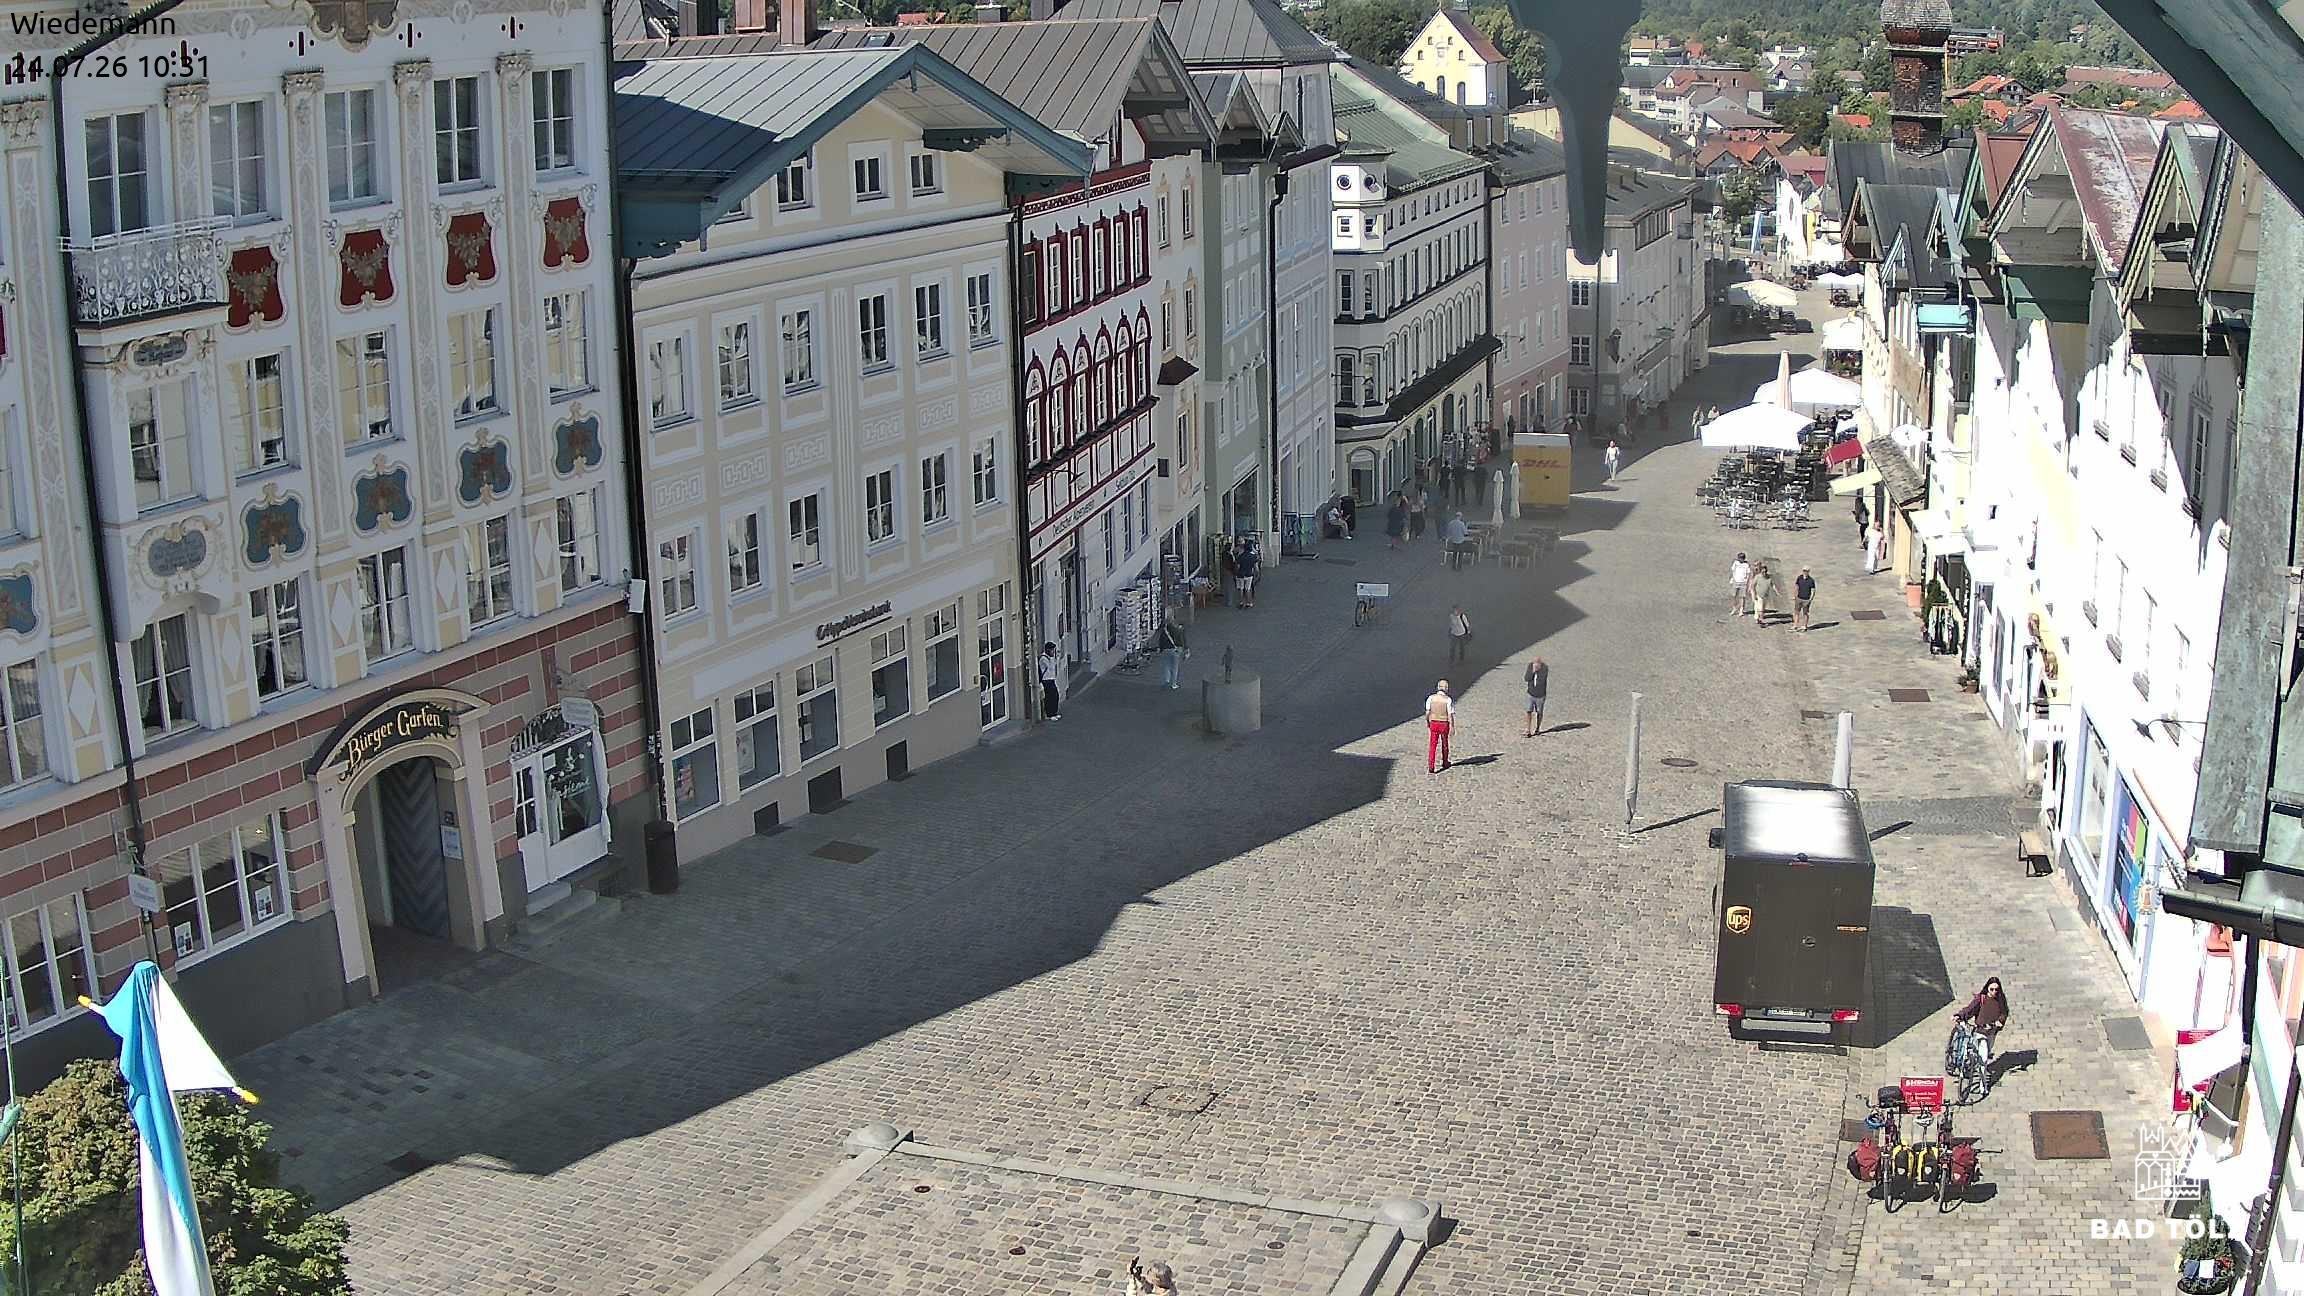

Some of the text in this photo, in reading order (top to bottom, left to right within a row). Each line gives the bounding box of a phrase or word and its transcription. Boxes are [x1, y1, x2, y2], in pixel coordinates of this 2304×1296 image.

[348, 707, 443, 768] Bürger Garten
[1728, 914, 1749, 929] ups
